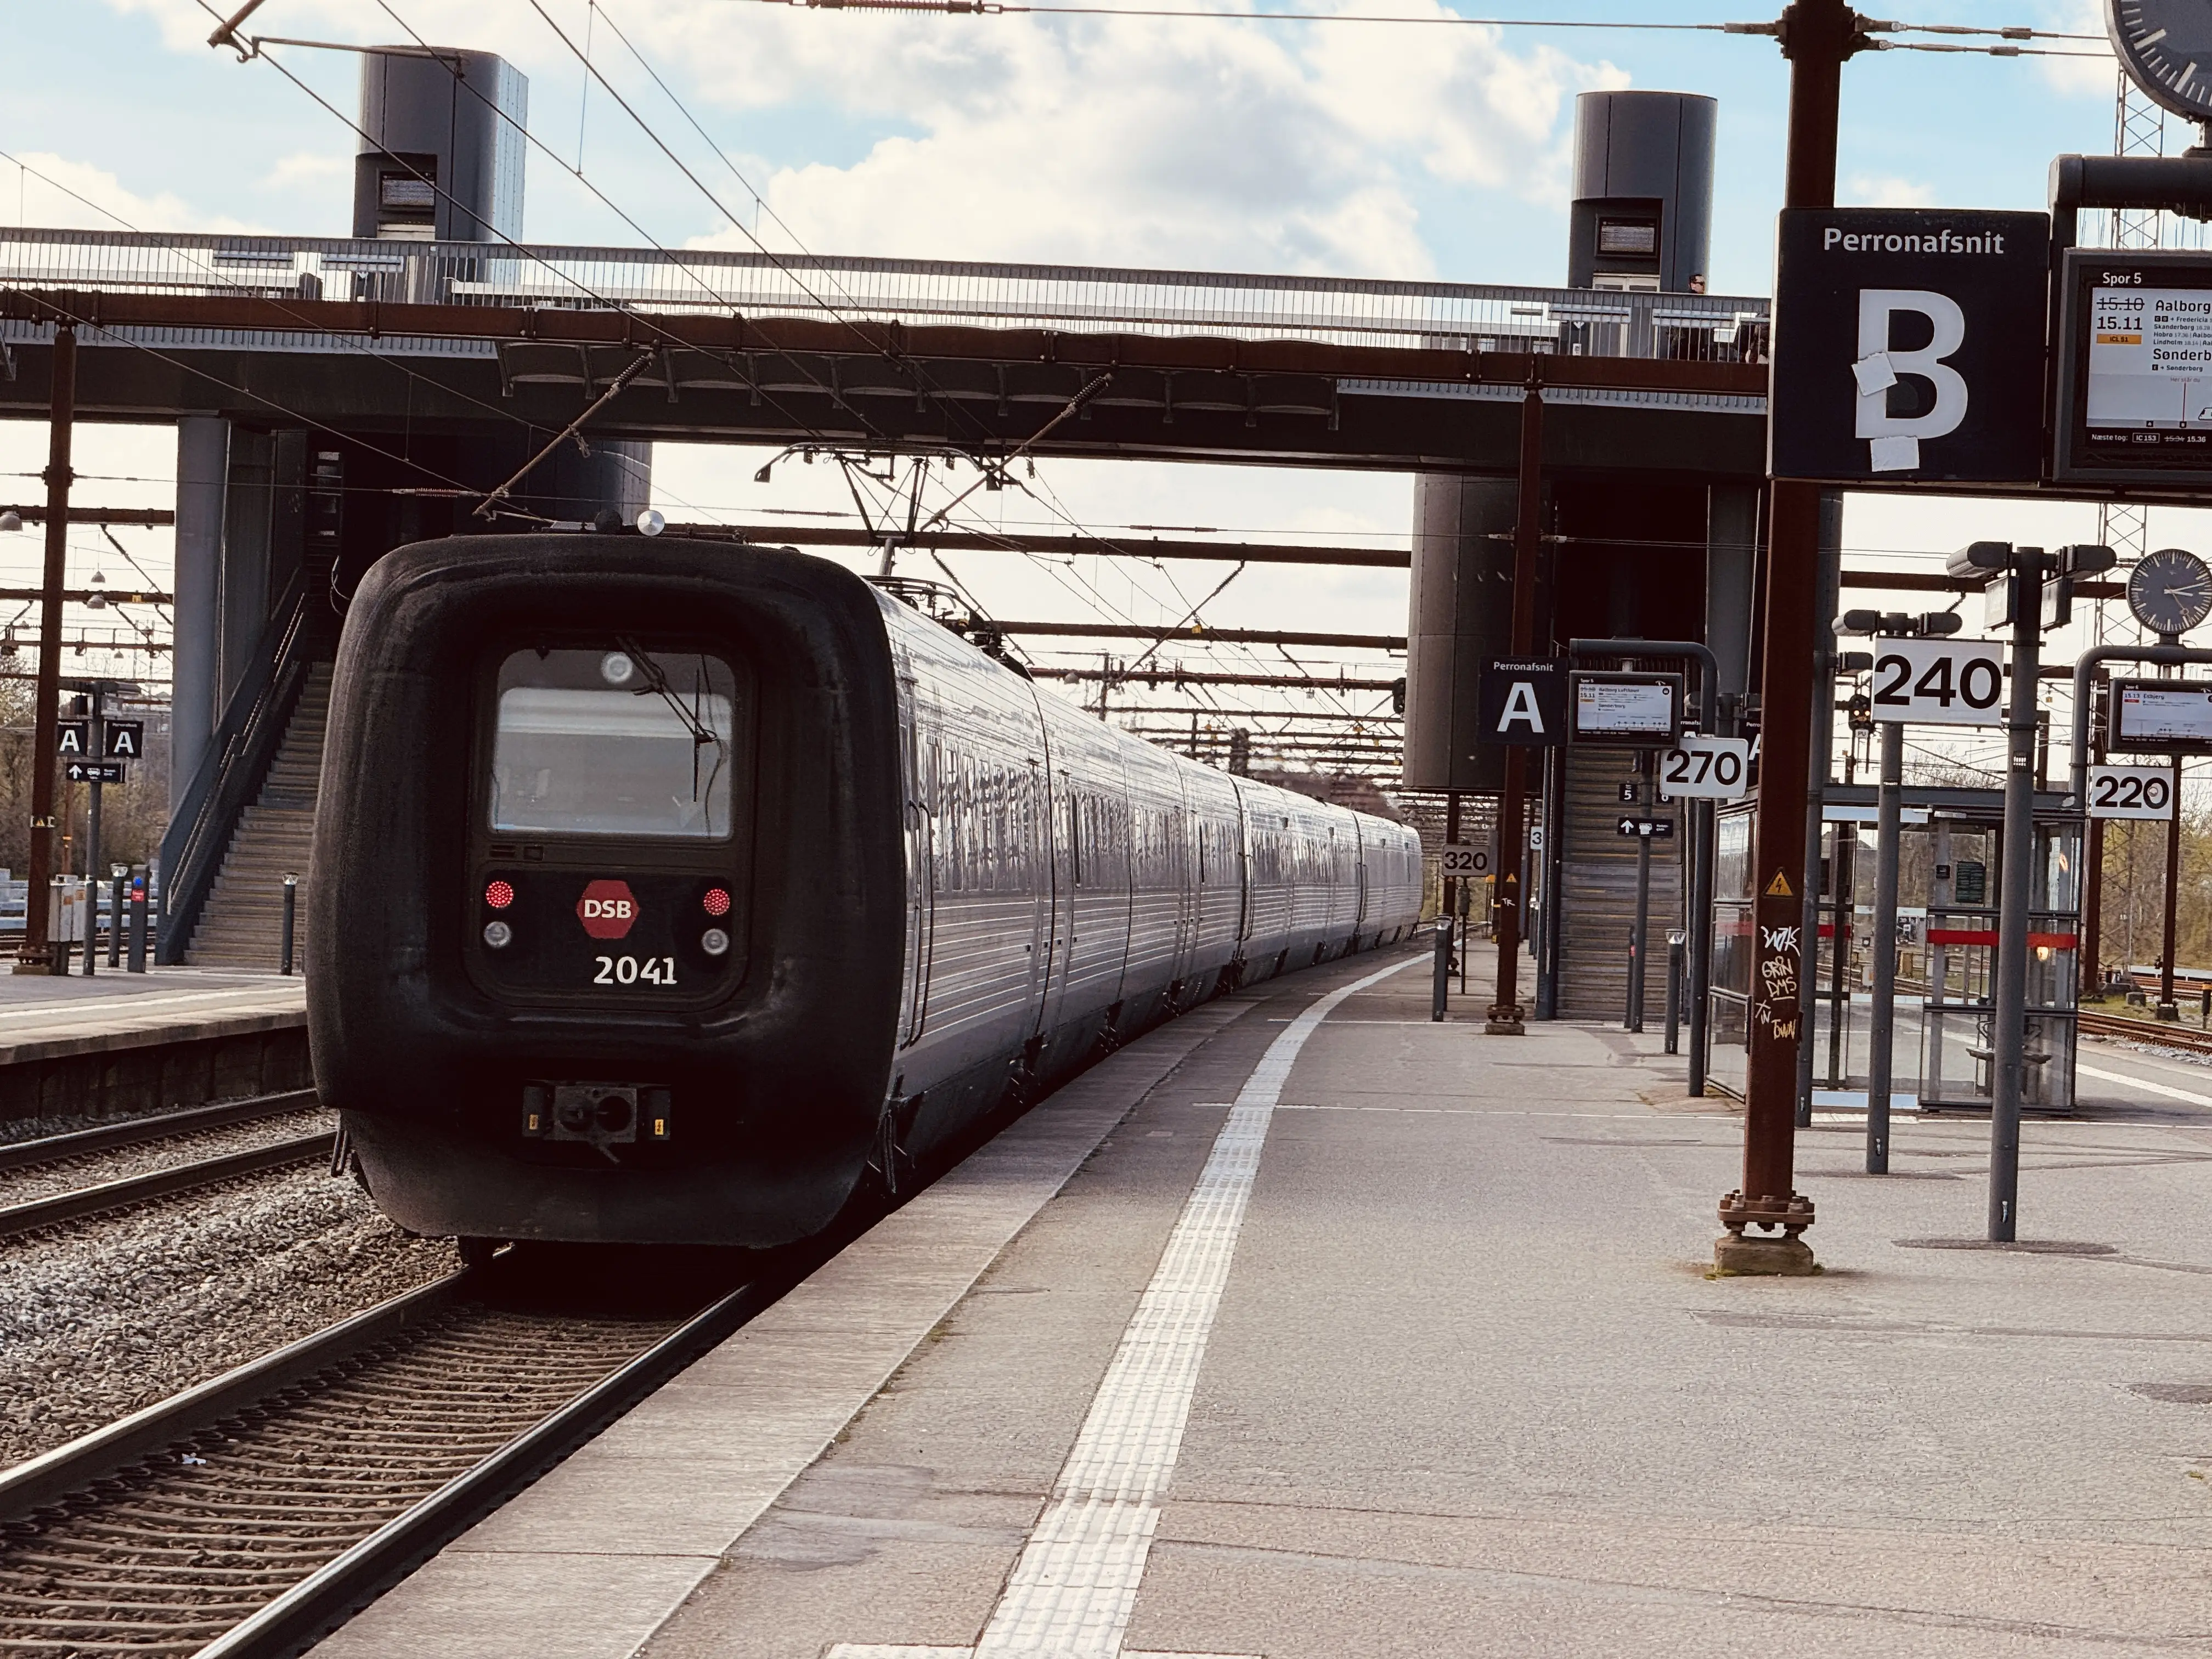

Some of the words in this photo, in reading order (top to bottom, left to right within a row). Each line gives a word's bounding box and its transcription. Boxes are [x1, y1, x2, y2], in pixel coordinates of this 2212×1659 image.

[1824, 228, 2004, 255] Perronafsnit
[2102, 273, 2131, 286] Spor
[2134, 272, 2142, 284] 5
[2155, 300, 2211, 314] Aalborg
[2097, 317, 2142, 330] 15.11
[1855, 289, 1968, 439] B
[2153, 348, 2211, 361] Sønderb
[1494, 662, 1554, 672] Perronafsnit
[1874, 654, 2002, 709] 240
[1497, 682, 1545, 733] A
[59, 730, 80, 752] A
[114, 731, 134, 754] A
[1666, 749, 1741, 786] 270
[1624, 790, 1632, 800] 5
[2095, 775, 2169, 809] 220
[1532, 832, 1542, 845] 3
[1444, 851, 1488, 871] 320
[584, 900, 631, 918] DSB
[594, 956, 678, 985] 2041
